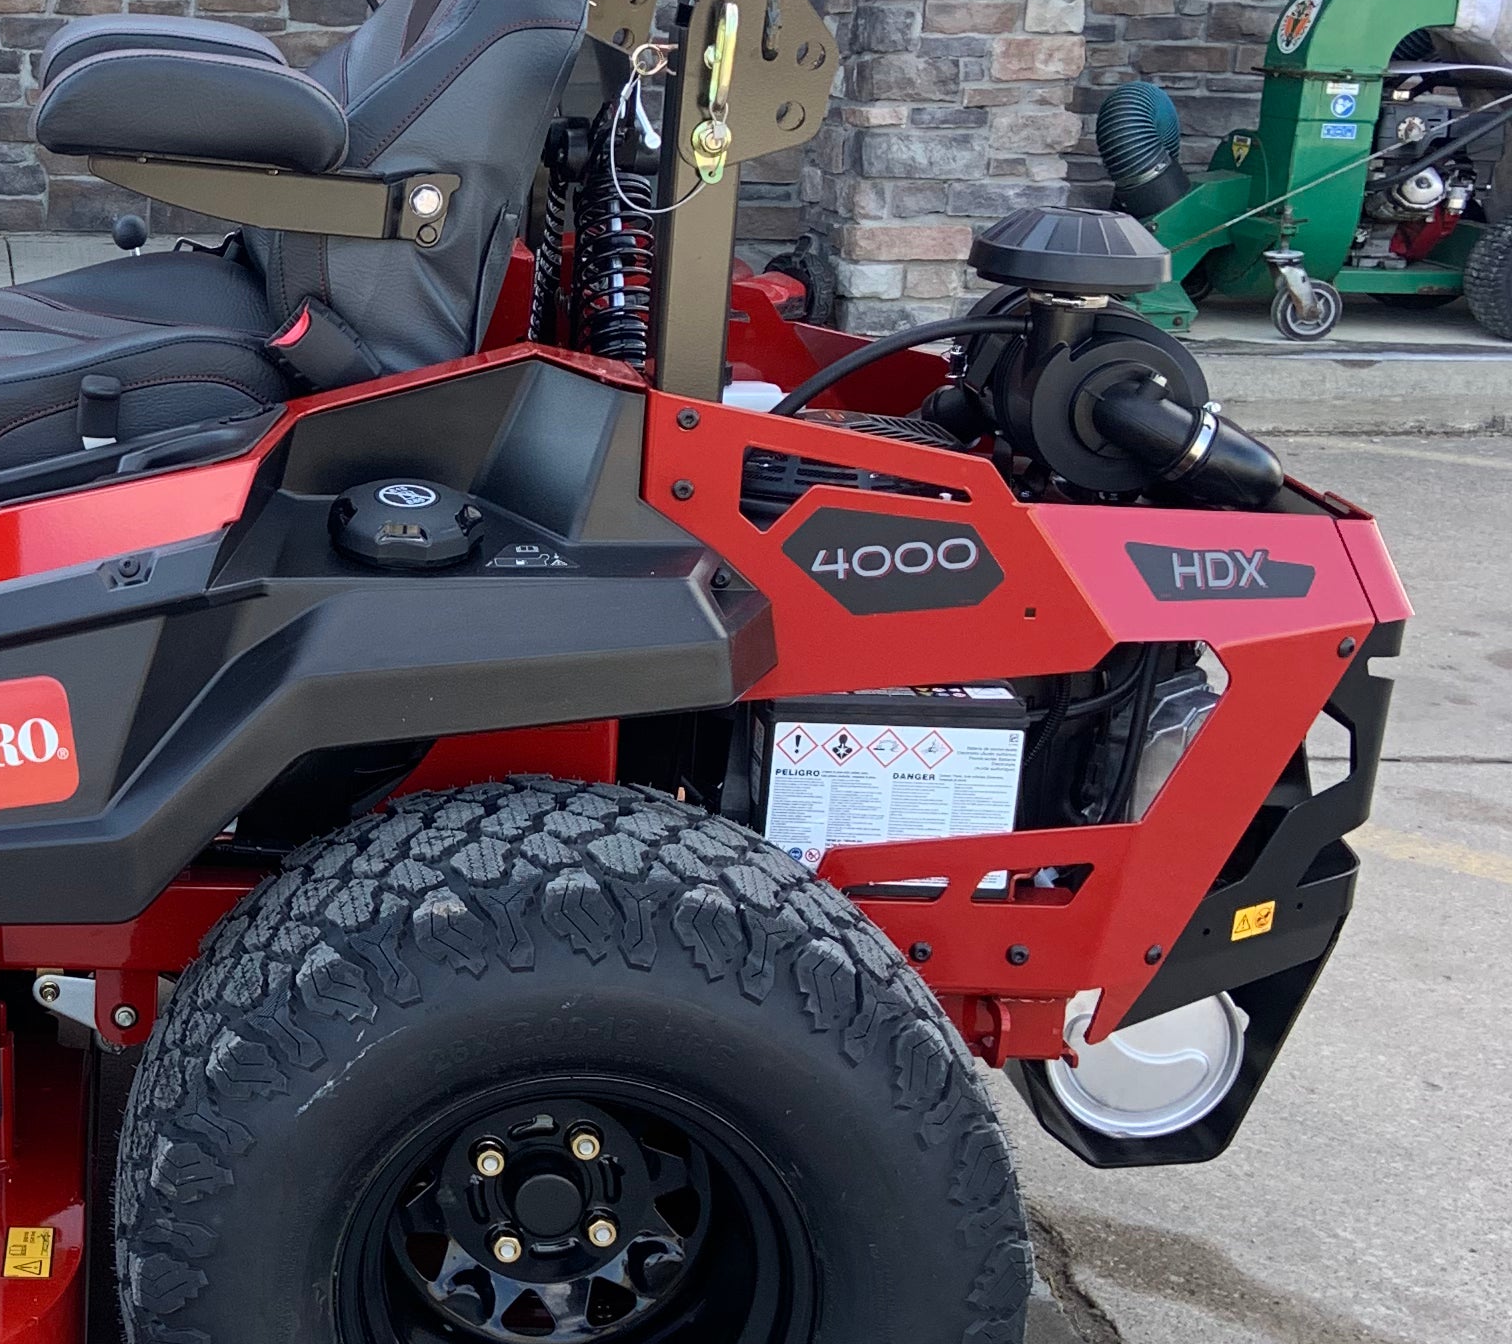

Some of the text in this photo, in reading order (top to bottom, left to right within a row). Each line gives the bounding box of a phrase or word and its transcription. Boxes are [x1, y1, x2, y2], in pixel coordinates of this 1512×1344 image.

[810, 537, 980, 581] 4000
[1171, 550, 1269, 591] HDX
[774, 768, 821, 777] PELIGRO
[892, 772, 936, 781] DANGER
